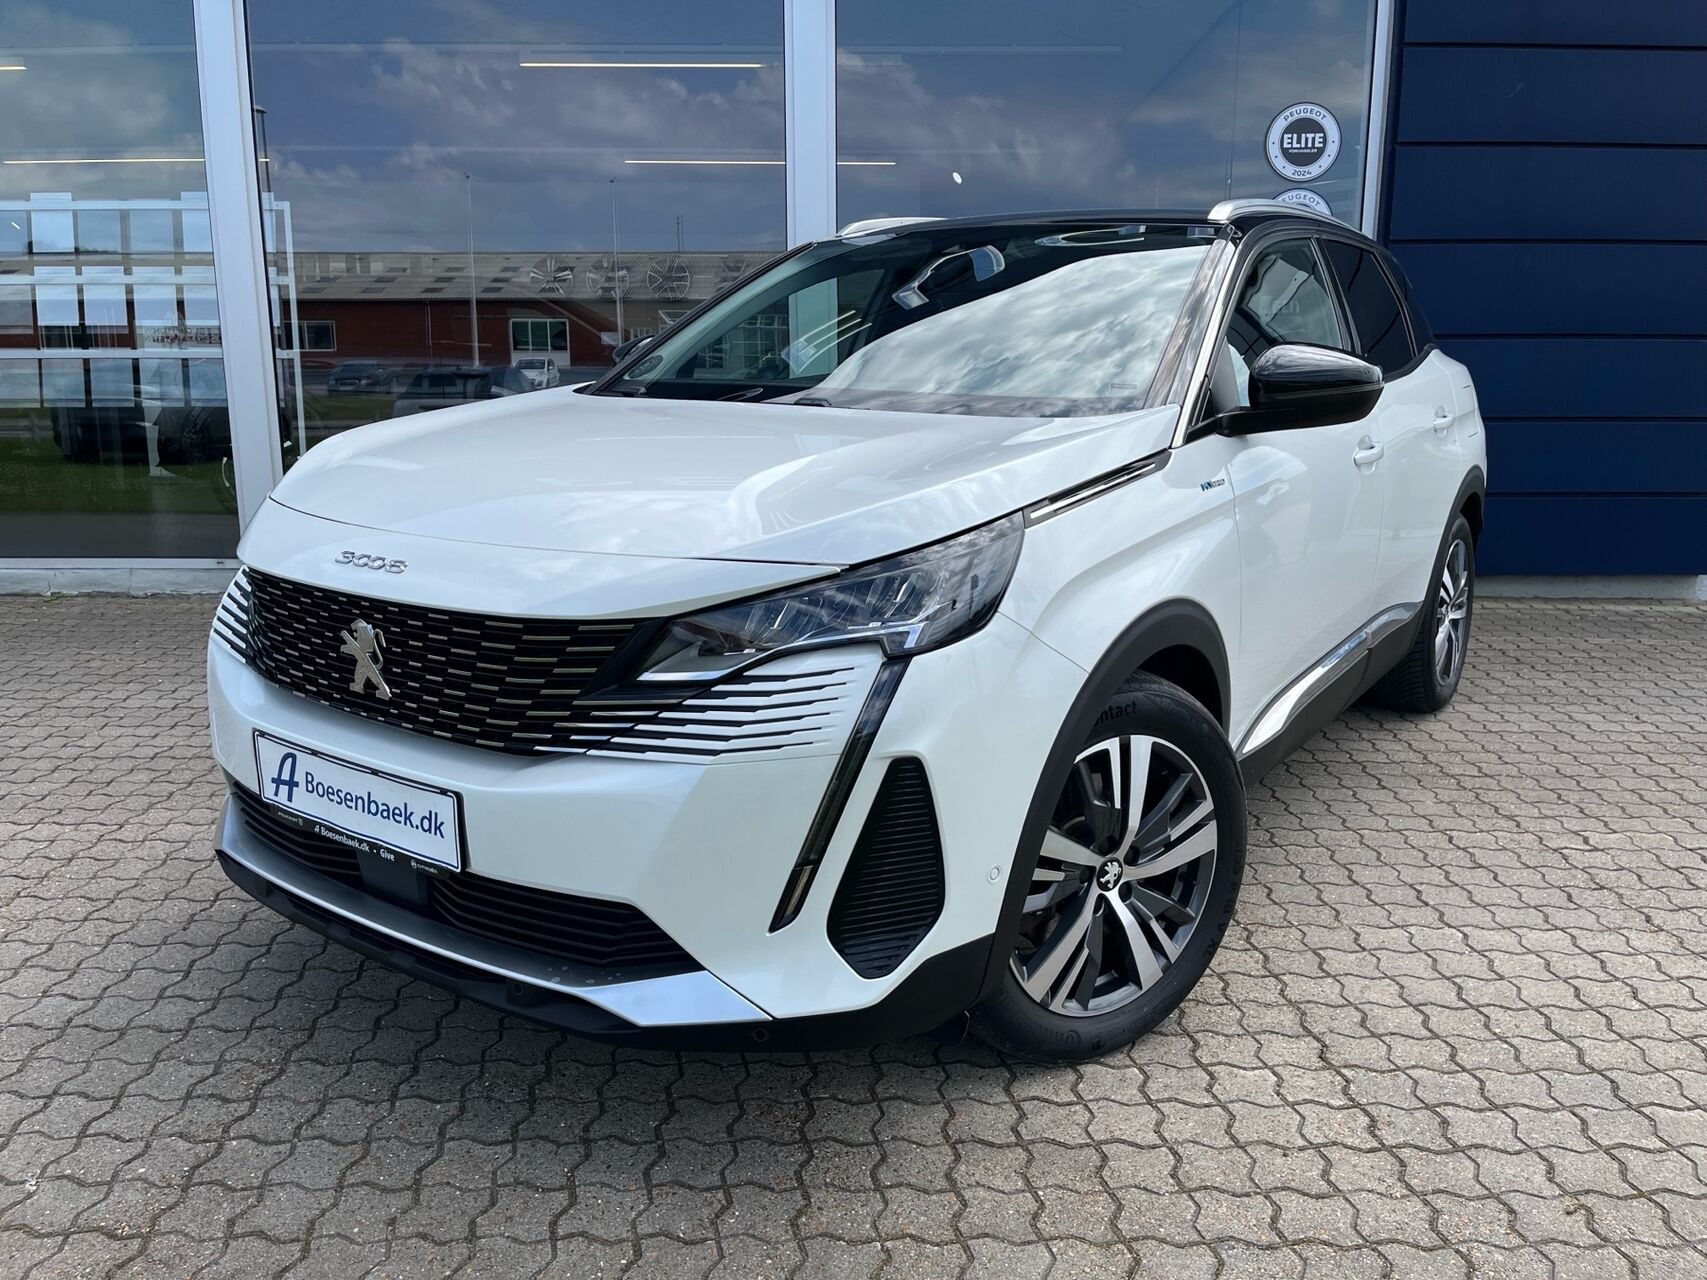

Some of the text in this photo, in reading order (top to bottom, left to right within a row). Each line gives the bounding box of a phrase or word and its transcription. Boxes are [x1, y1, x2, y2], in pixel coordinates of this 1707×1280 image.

[1283, 107, 1327, 121] PEUGEOT
[1283, 133, 1324, 148] ELITE
[1282, 194, 1320, 206] EUGEOT
[334, 550, 409, 574] 3008
[1098, 701, 1137, 724] ntact
[305, 771, 445, 839] Boesenbaek.dk
[321, 826, 370, 852] Boesenbaek.dk
[380, 848, 395, 862] Give
